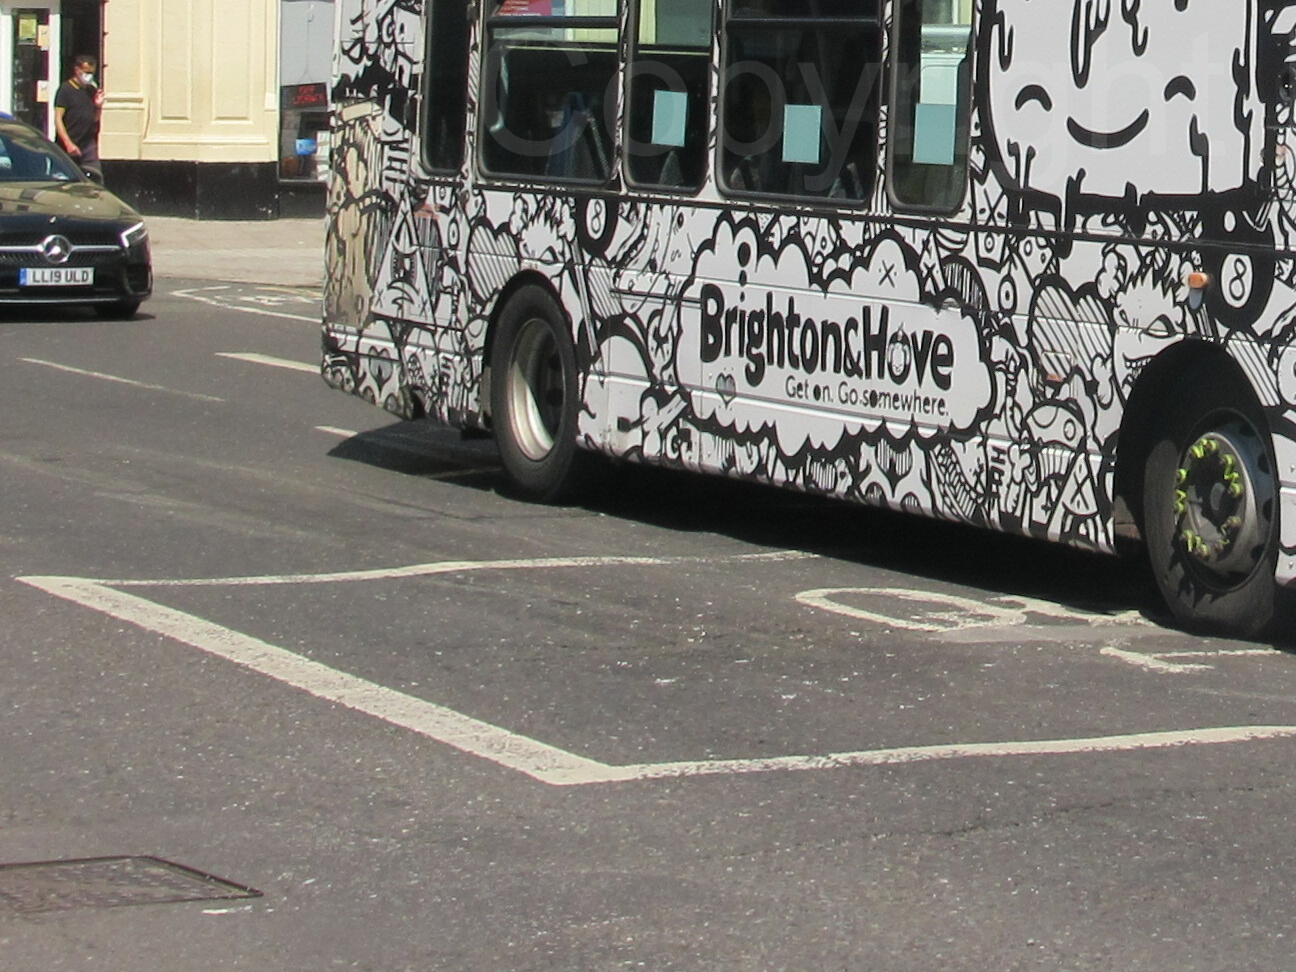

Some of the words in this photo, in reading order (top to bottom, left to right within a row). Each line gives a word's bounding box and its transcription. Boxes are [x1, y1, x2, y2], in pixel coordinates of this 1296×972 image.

[32, 270, 61, 283] LL19
[65, 270, 89, 282] ULD
[785, 375, 809, 399] Get
[863, 386, 949, 416] somewhere.
